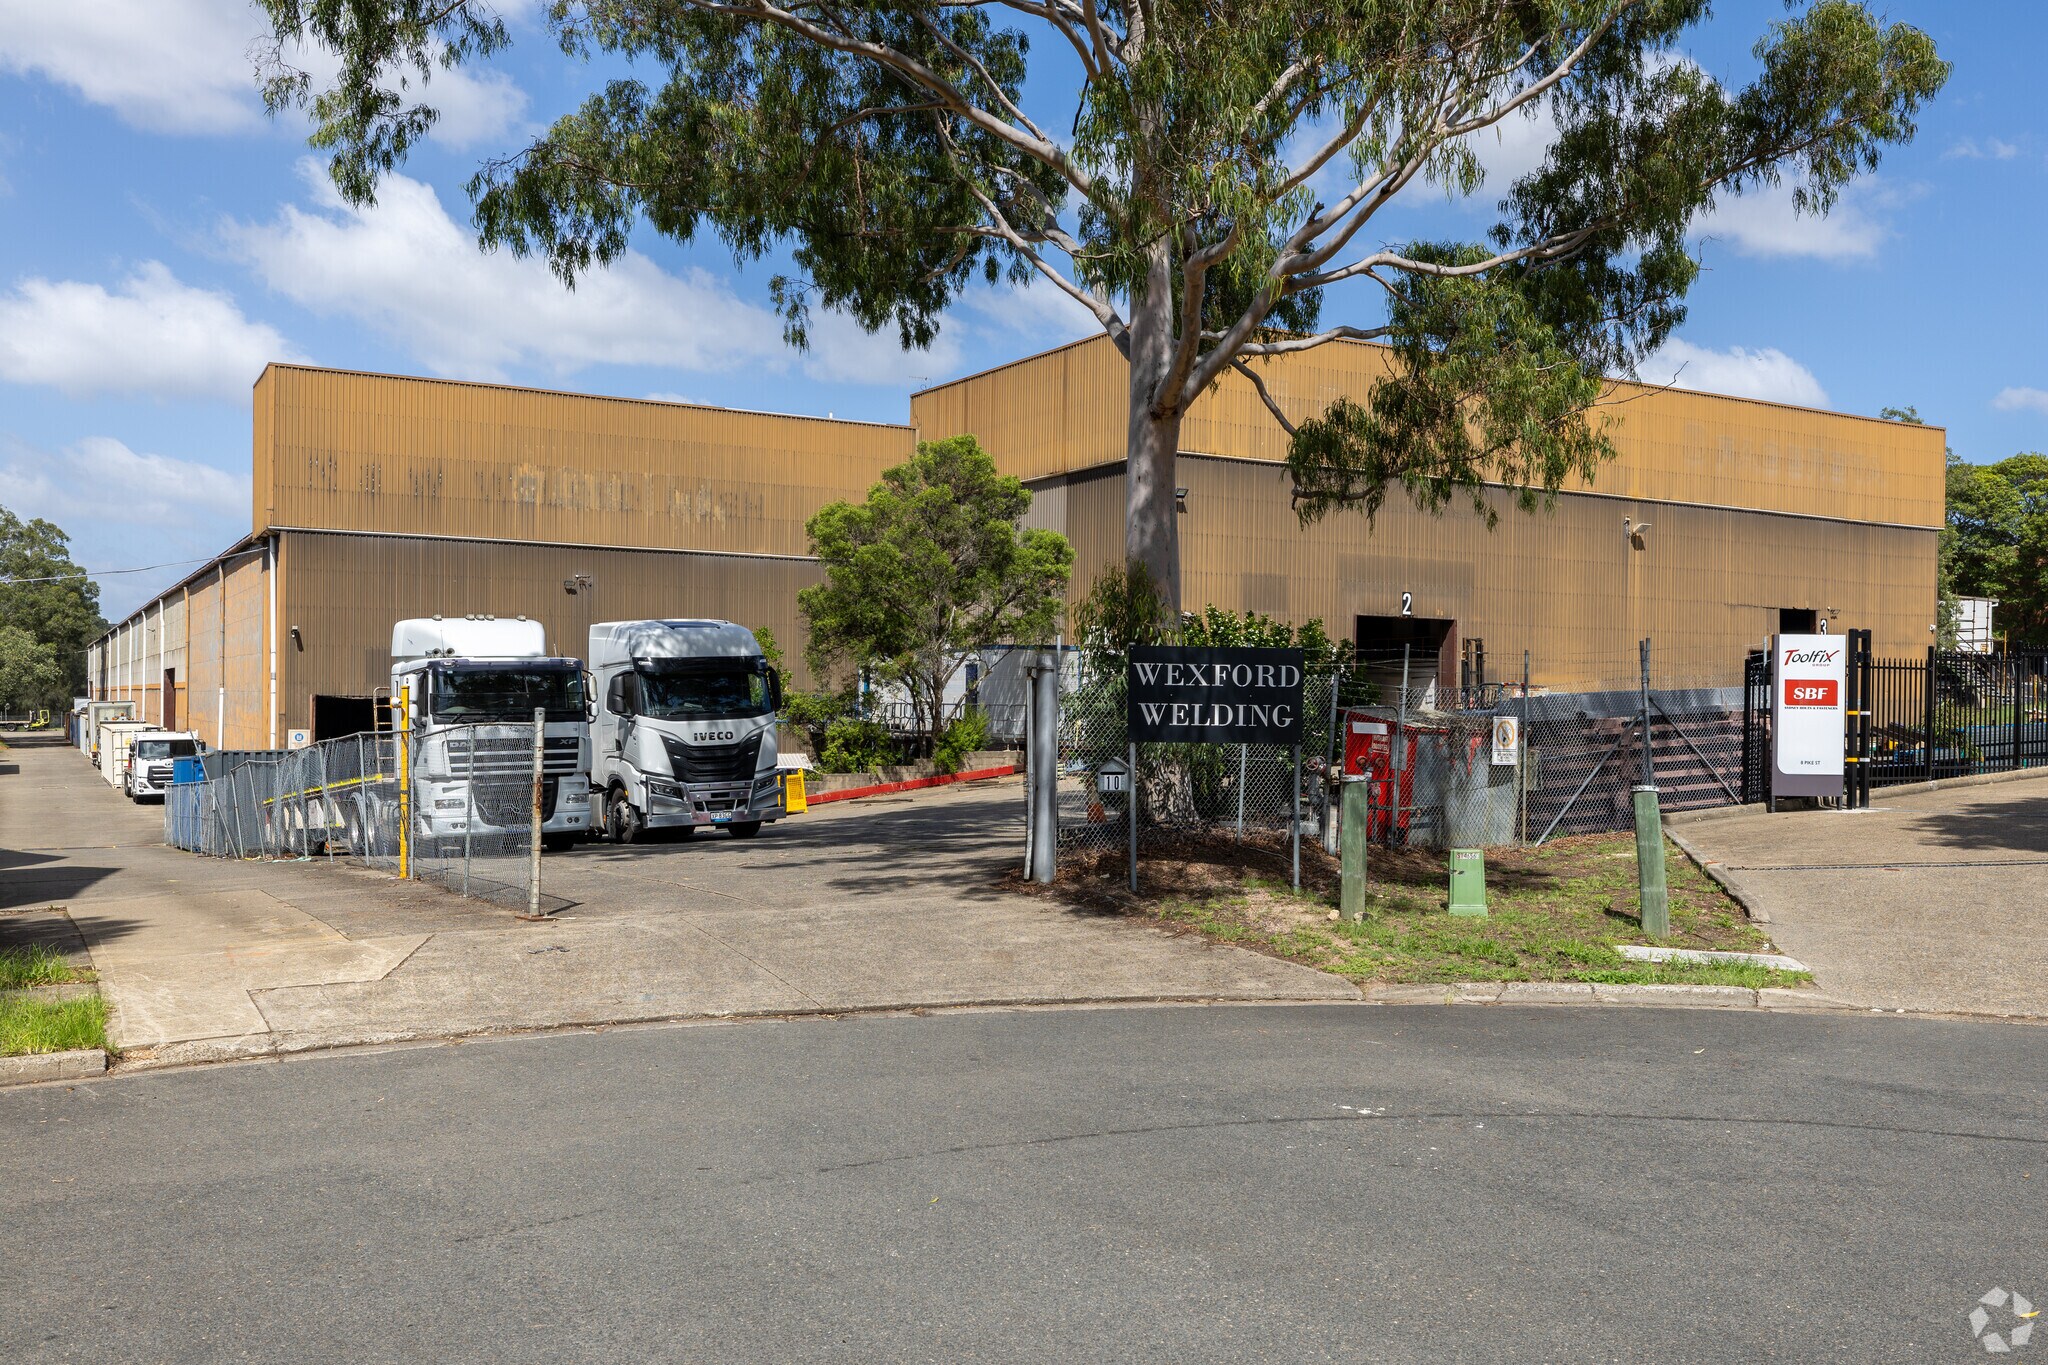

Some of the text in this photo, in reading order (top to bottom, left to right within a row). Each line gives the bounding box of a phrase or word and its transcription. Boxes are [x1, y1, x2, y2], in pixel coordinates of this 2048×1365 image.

[1402, 592, 1412, 615] 2
[1821, 619, 1827, 635] 3
[1784, 649, 1840, 666] Toolfix
[1132, 662, 1300, 688] WEXFORD
[1793, 687, 1829, 700] SBF
[1137, 702, 1294, 728] WELDING
[693, 731, 734, 742] IVECO
[1106, 775, 1120, 790] 10
